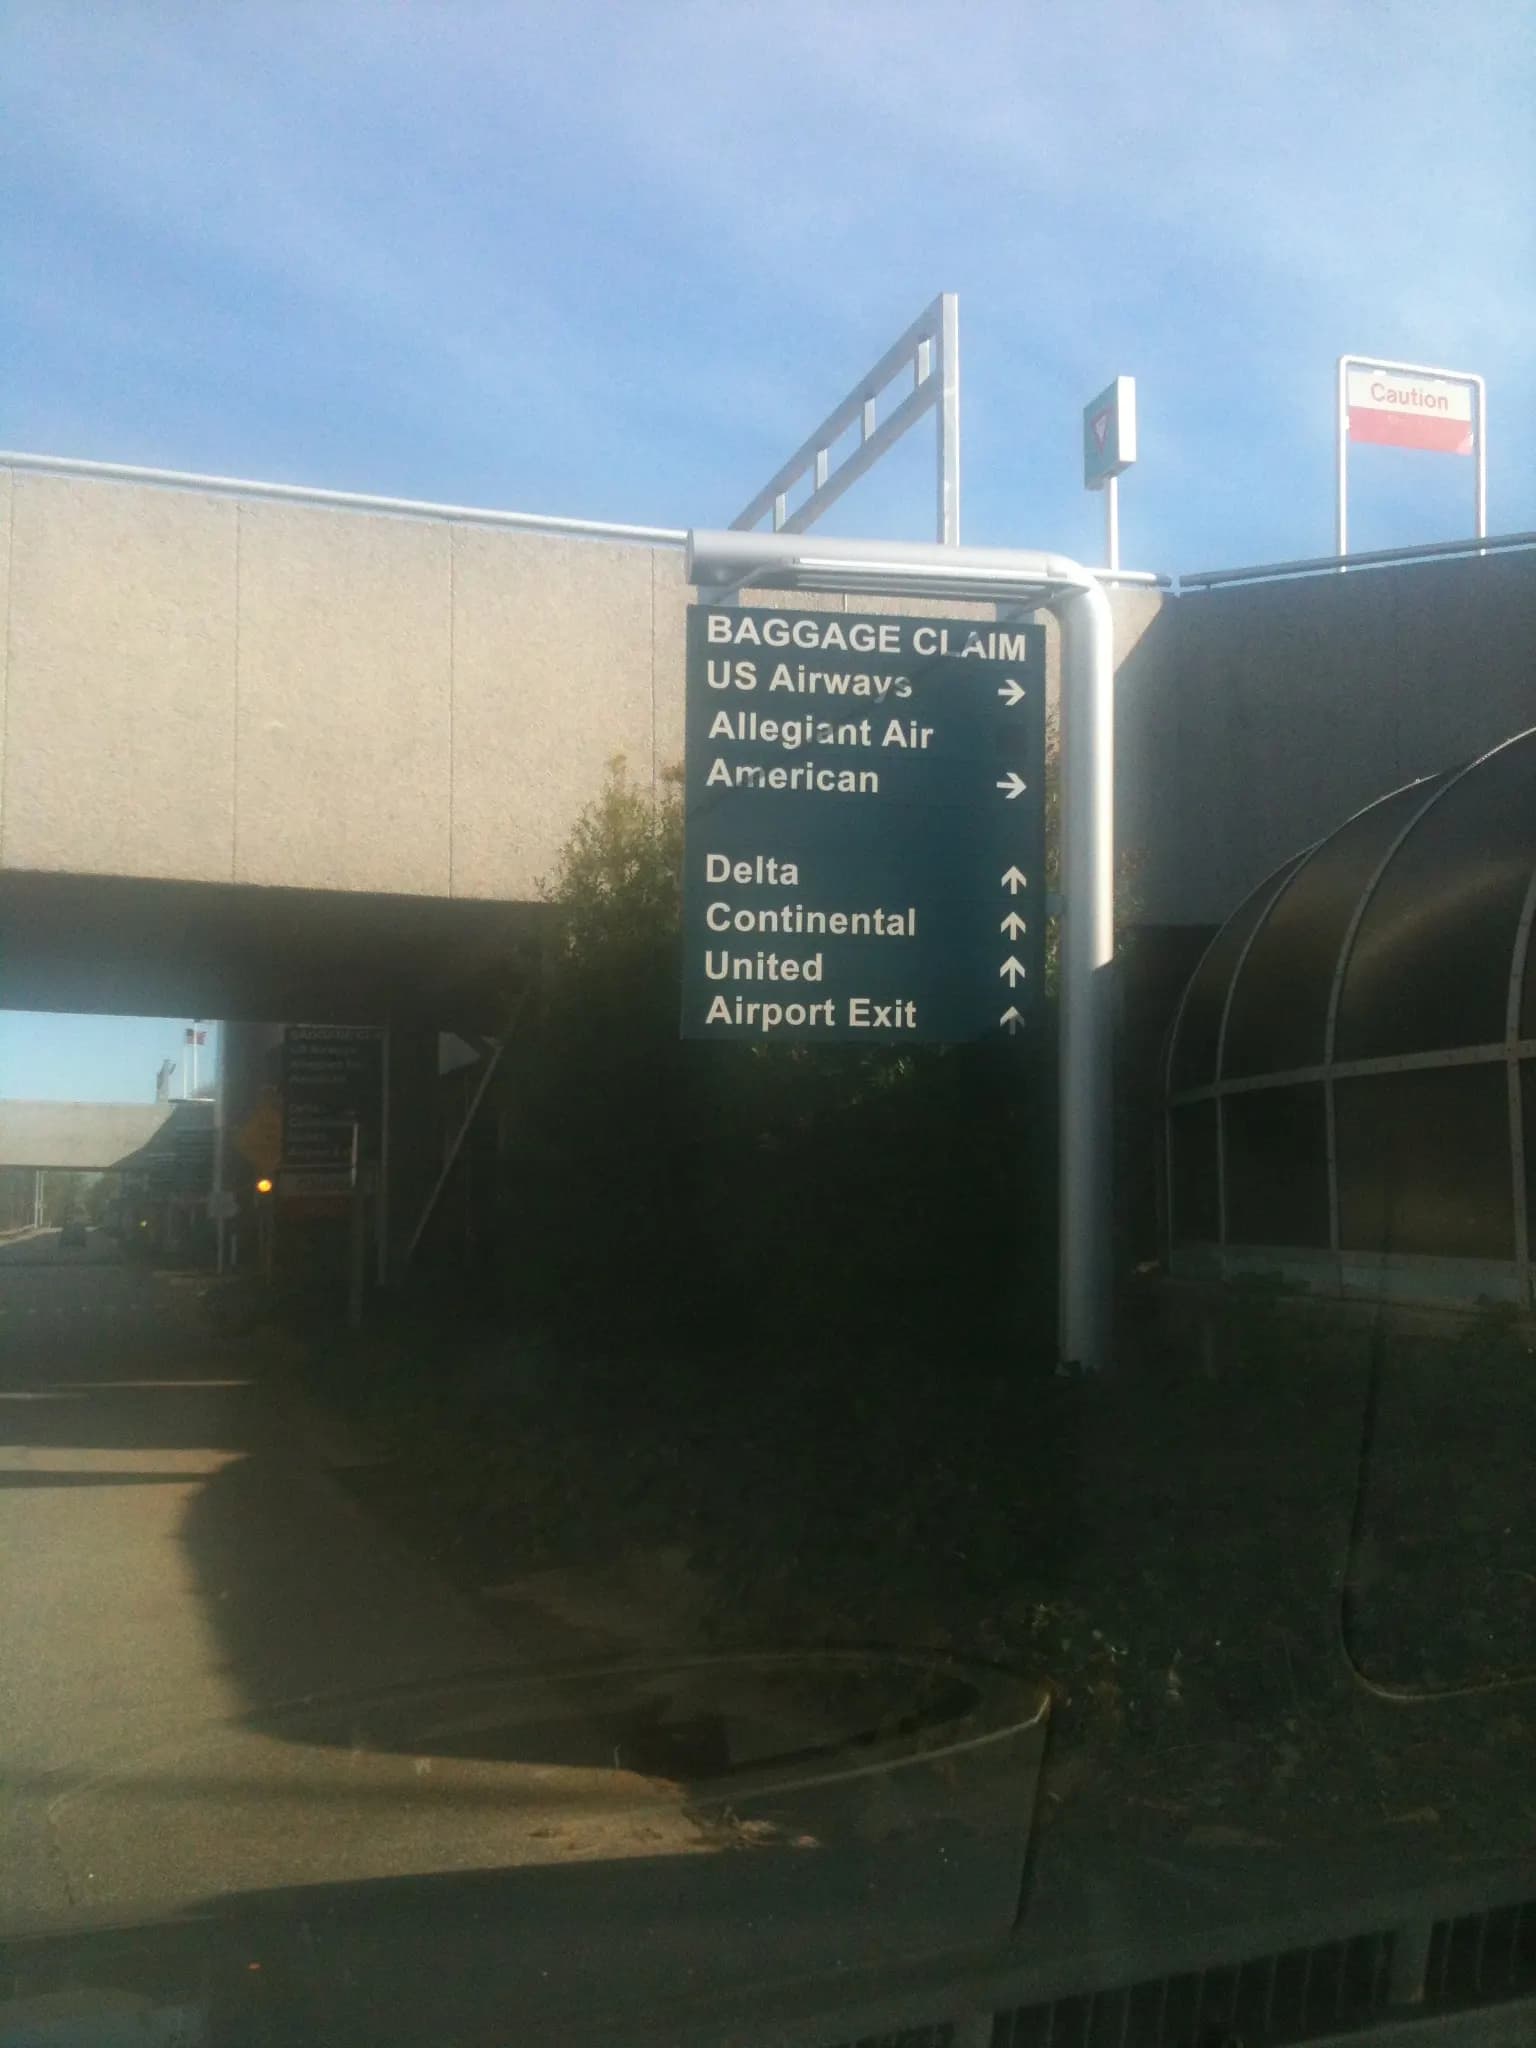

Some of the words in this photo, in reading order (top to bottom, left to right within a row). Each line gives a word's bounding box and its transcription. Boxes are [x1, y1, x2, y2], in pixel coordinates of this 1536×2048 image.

[1370, 382, 1449, 410] Caution
[707, 614, 900, 653] BAGGAGE
[913, 627, 1026, 662] CLAIM
[707, 660, 757, 690] US
[769, 664, 912, 704] Airways
[708, 711, 871, 750] Allegiant
[881, 720, 934, 749] Air
[706, 758, 879, 793] American
[706, 854, 799, 886] Delta
[706, 902, 916, 936] Continental
[705, 950, 823, 982] United
[705, 996, 835, 1031] Airport
[849, 998, 917, 1028] Exit
